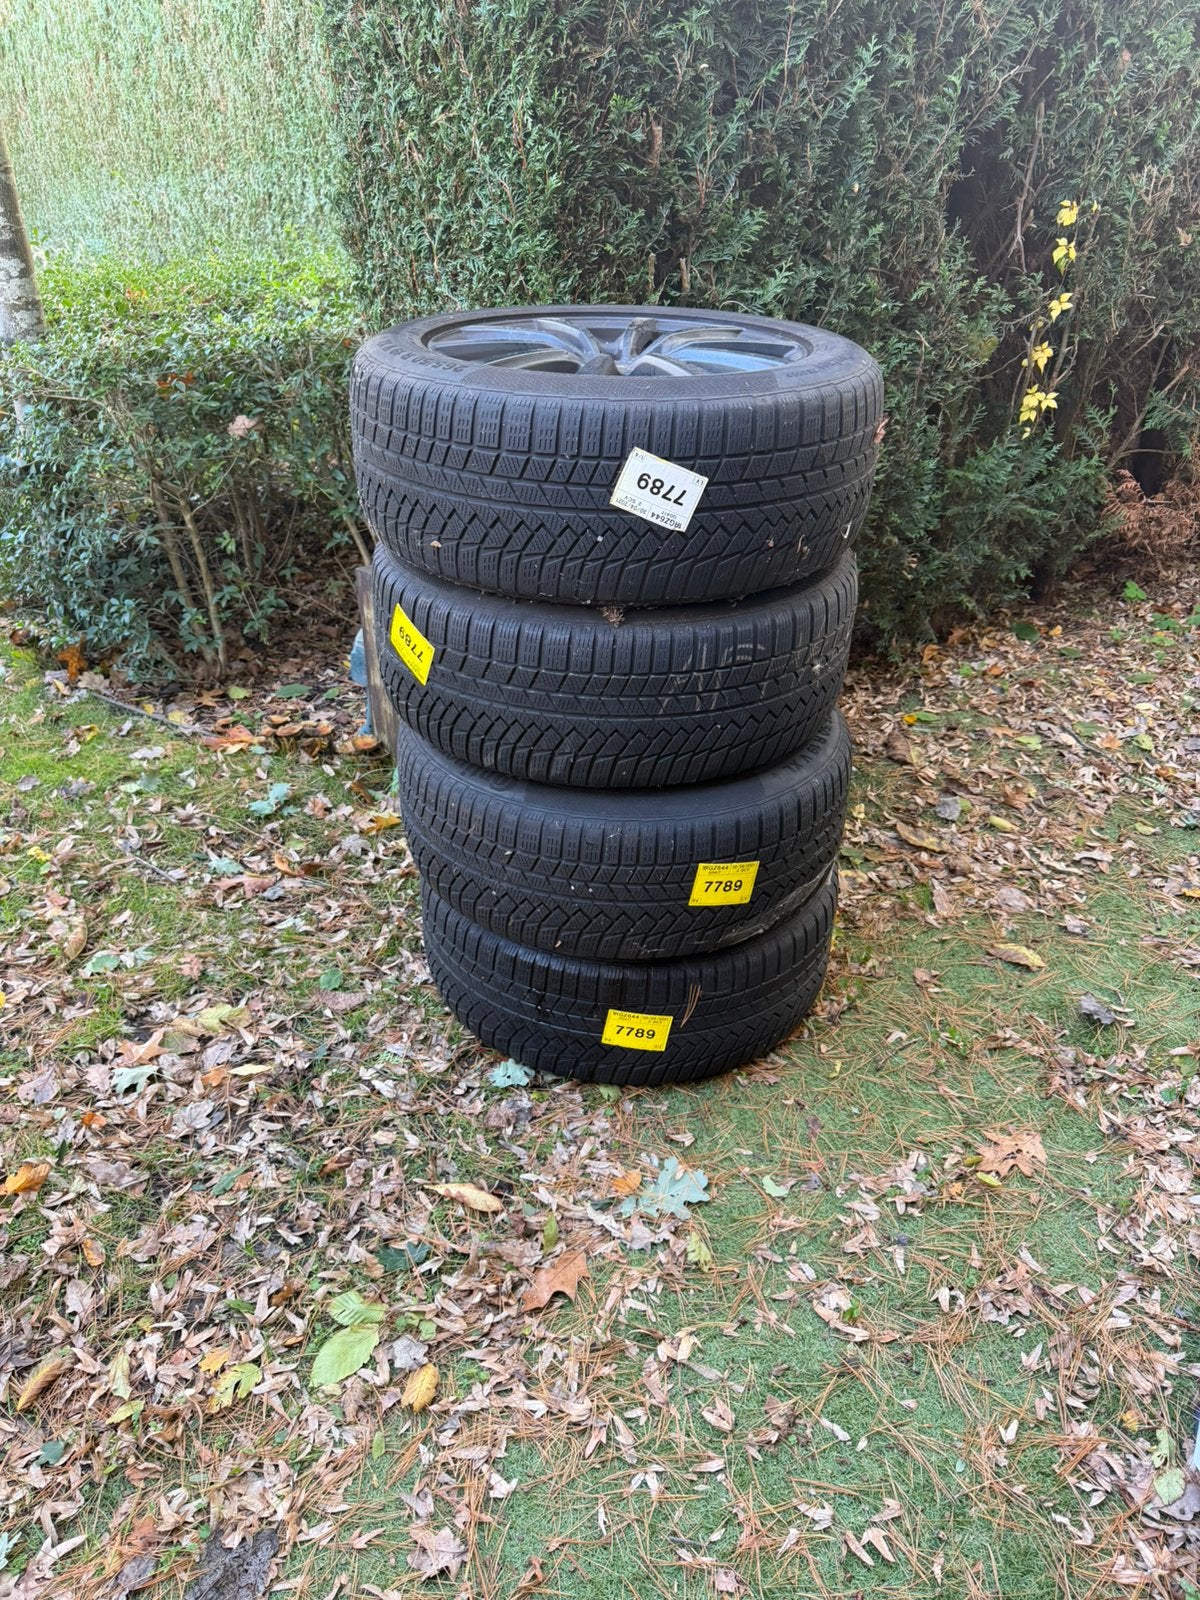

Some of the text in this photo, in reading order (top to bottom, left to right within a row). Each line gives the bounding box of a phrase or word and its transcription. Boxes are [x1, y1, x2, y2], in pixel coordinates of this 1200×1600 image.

[637, 473, 686, 506] 7789
[399, 627, 423, 662] 7789
[705, 880, 742, 892] 7789
[616, 1025, 655, 1039] 7789
